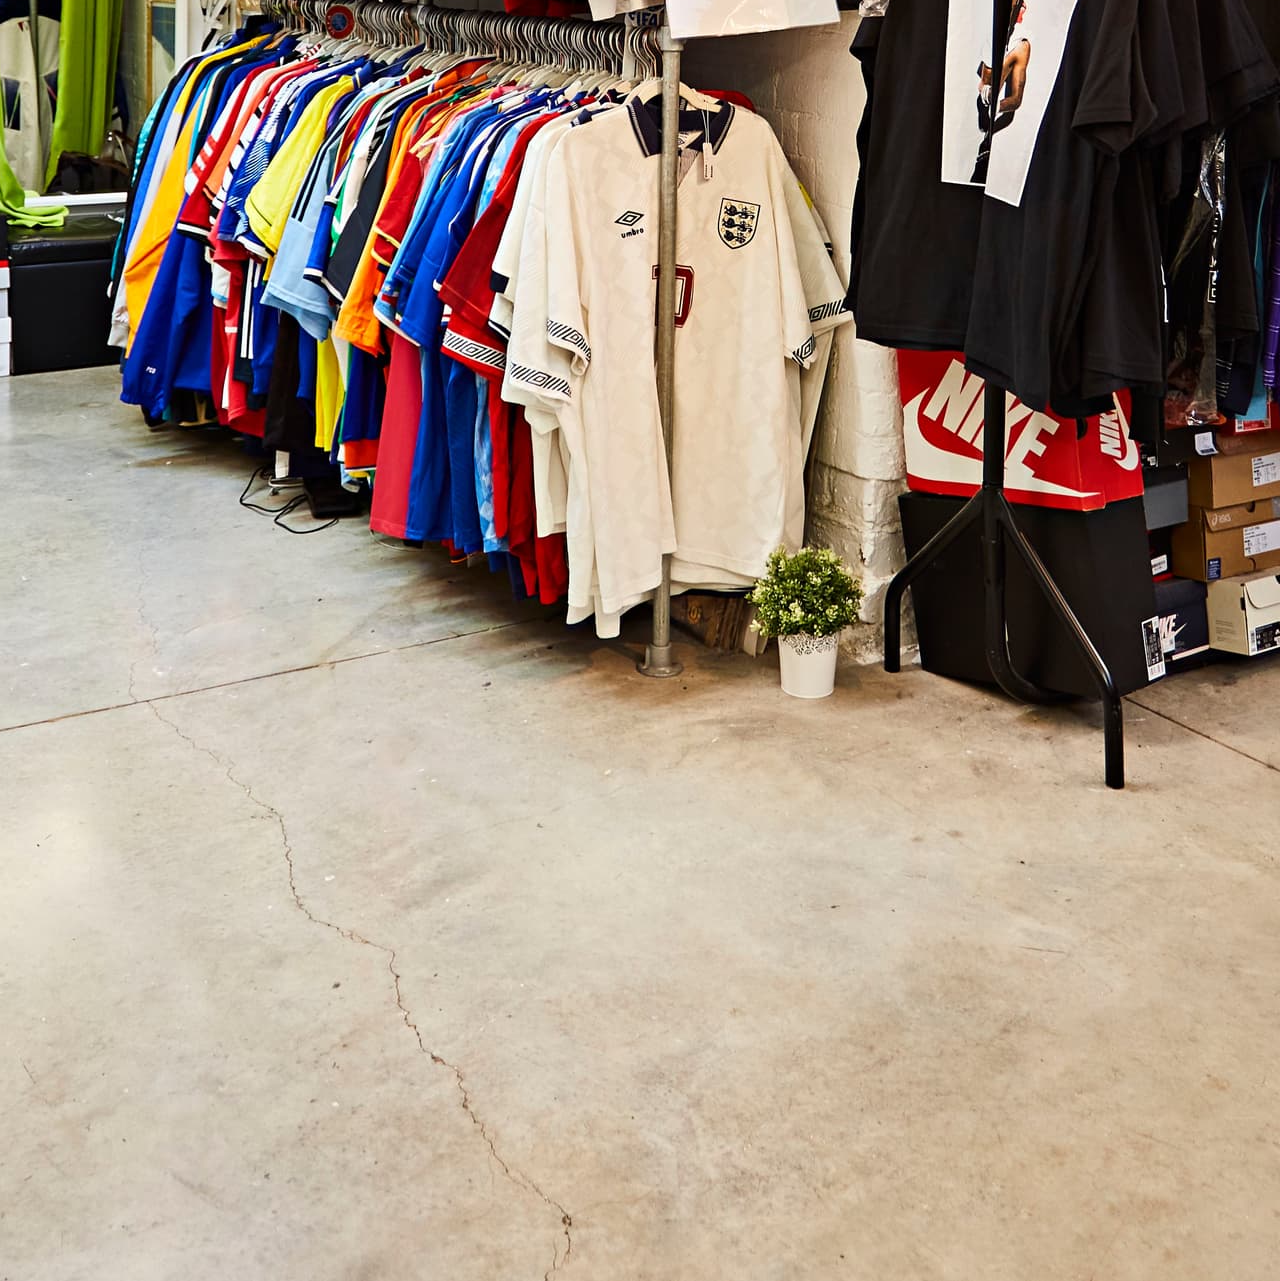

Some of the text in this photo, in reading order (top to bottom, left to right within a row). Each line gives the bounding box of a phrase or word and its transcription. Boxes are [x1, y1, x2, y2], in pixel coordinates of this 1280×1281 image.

[621, 227, 644, 239] umbro
[922, 358, 1060, 479] NIKE
[1099, 408, 1122, 459] NIK
